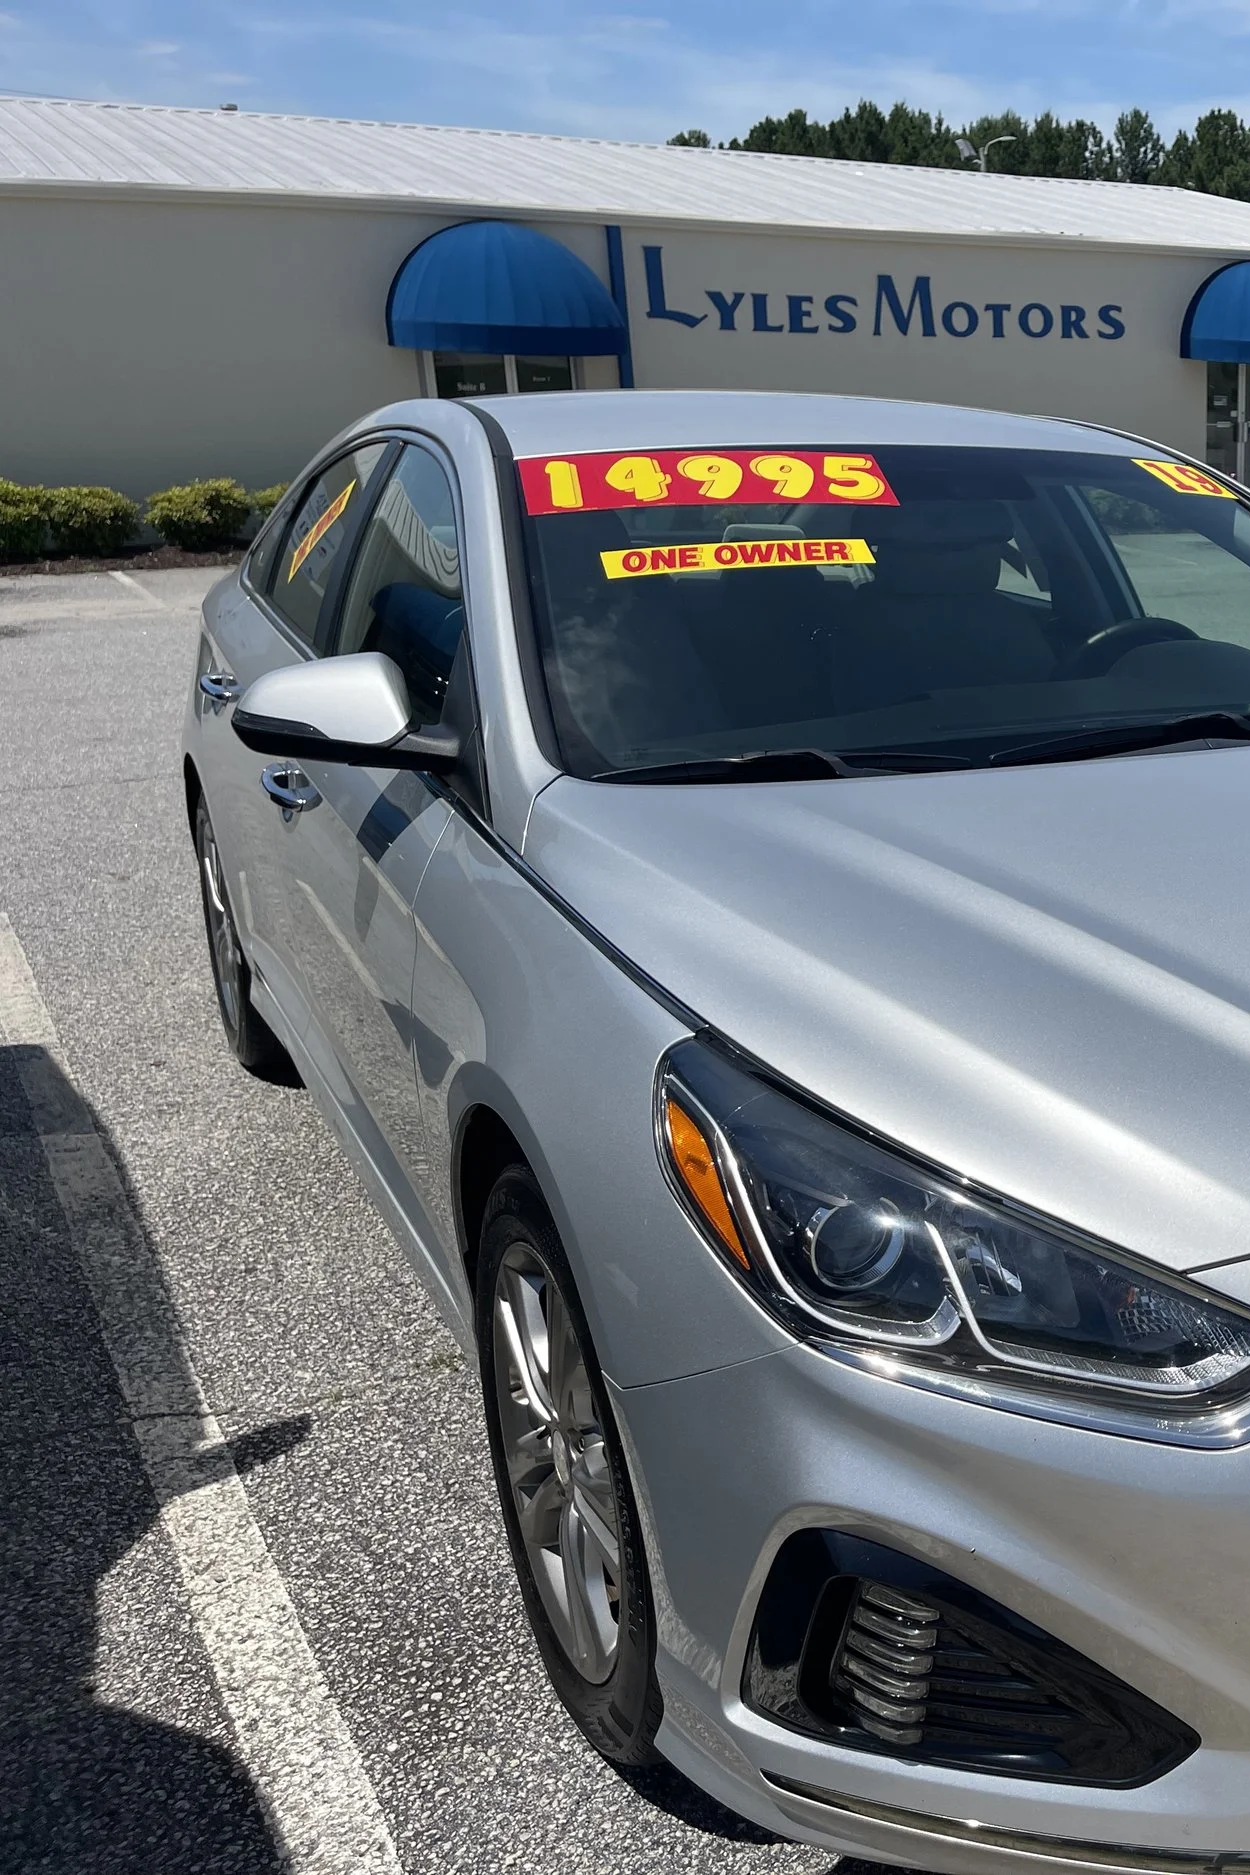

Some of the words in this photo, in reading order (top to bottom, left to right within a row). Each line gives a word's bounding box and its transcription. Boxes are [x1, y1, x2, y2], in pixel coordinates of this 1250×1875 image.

[642, 245, 858, 334] LYLES
[872, 274, 1126, 340] MOTORS
[544, 454, 886, 509] 14995
[1143, 461, 1223, 495] 19
[621, 547, 704, 573] ONE
[713, 541, 853, 566] OWNER
